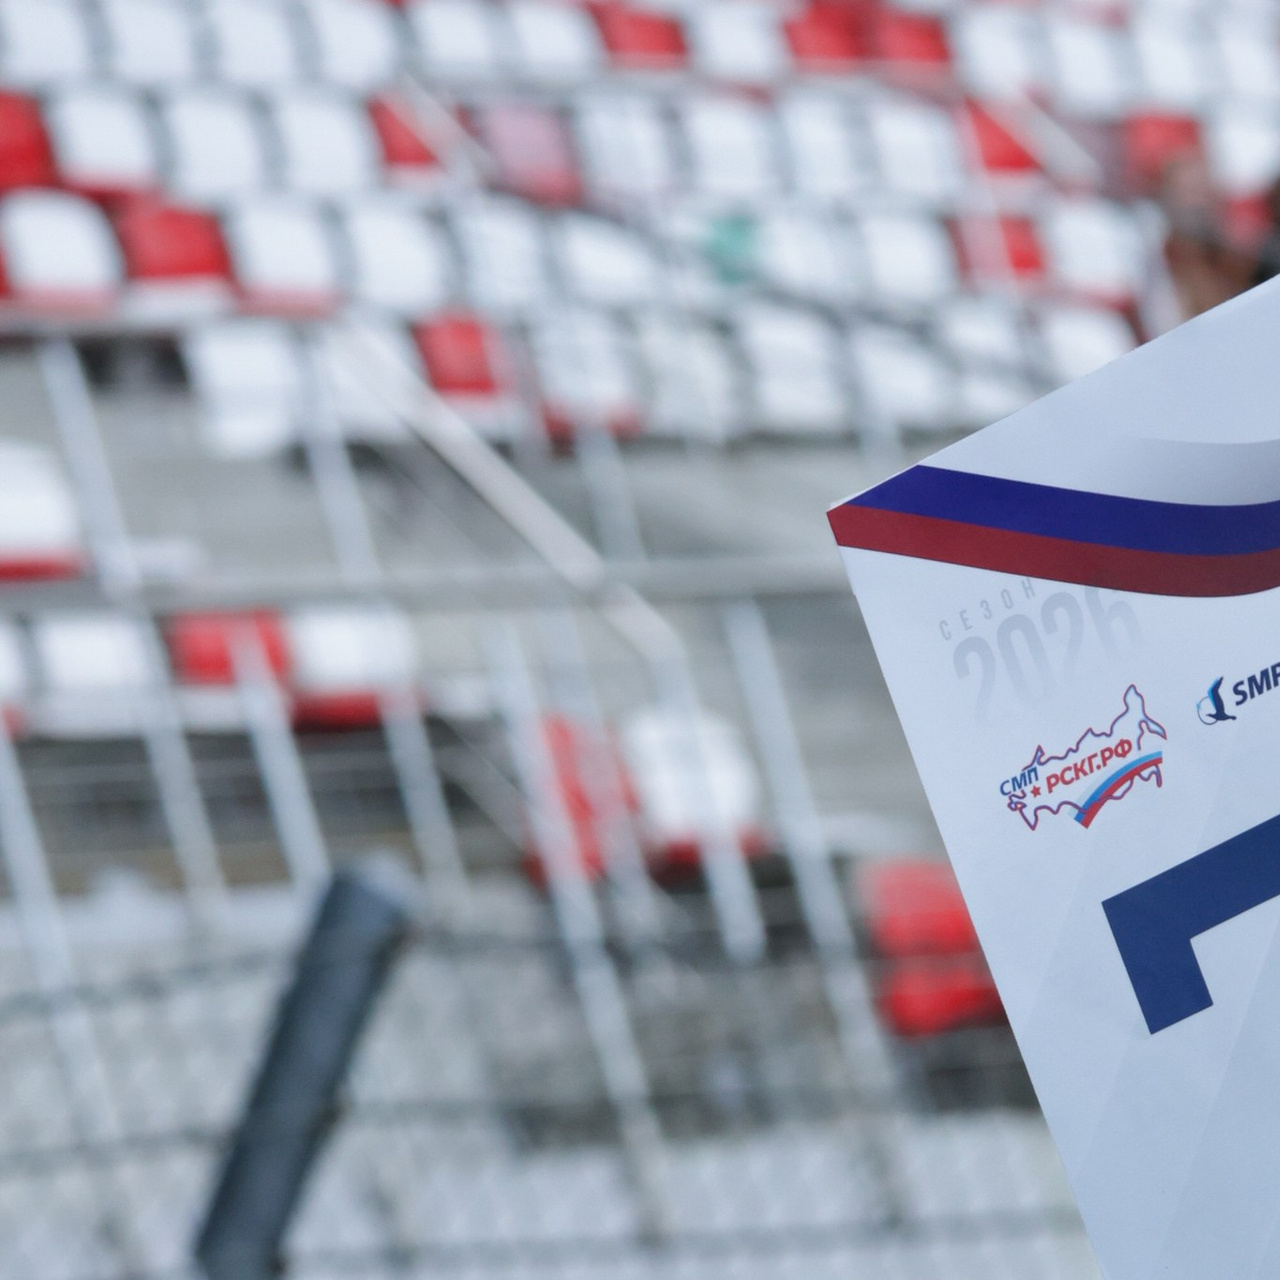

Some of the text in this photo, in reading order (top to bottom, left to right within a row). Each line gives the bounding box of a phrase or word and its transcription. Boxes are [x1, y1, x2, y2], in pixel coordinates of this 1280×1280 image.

[938, 576, 1036, 641] СЕЗОН
[1000, 767, 1040, 797] СМП
[1046, 738, 1133, 794] РСКГ.РФ
